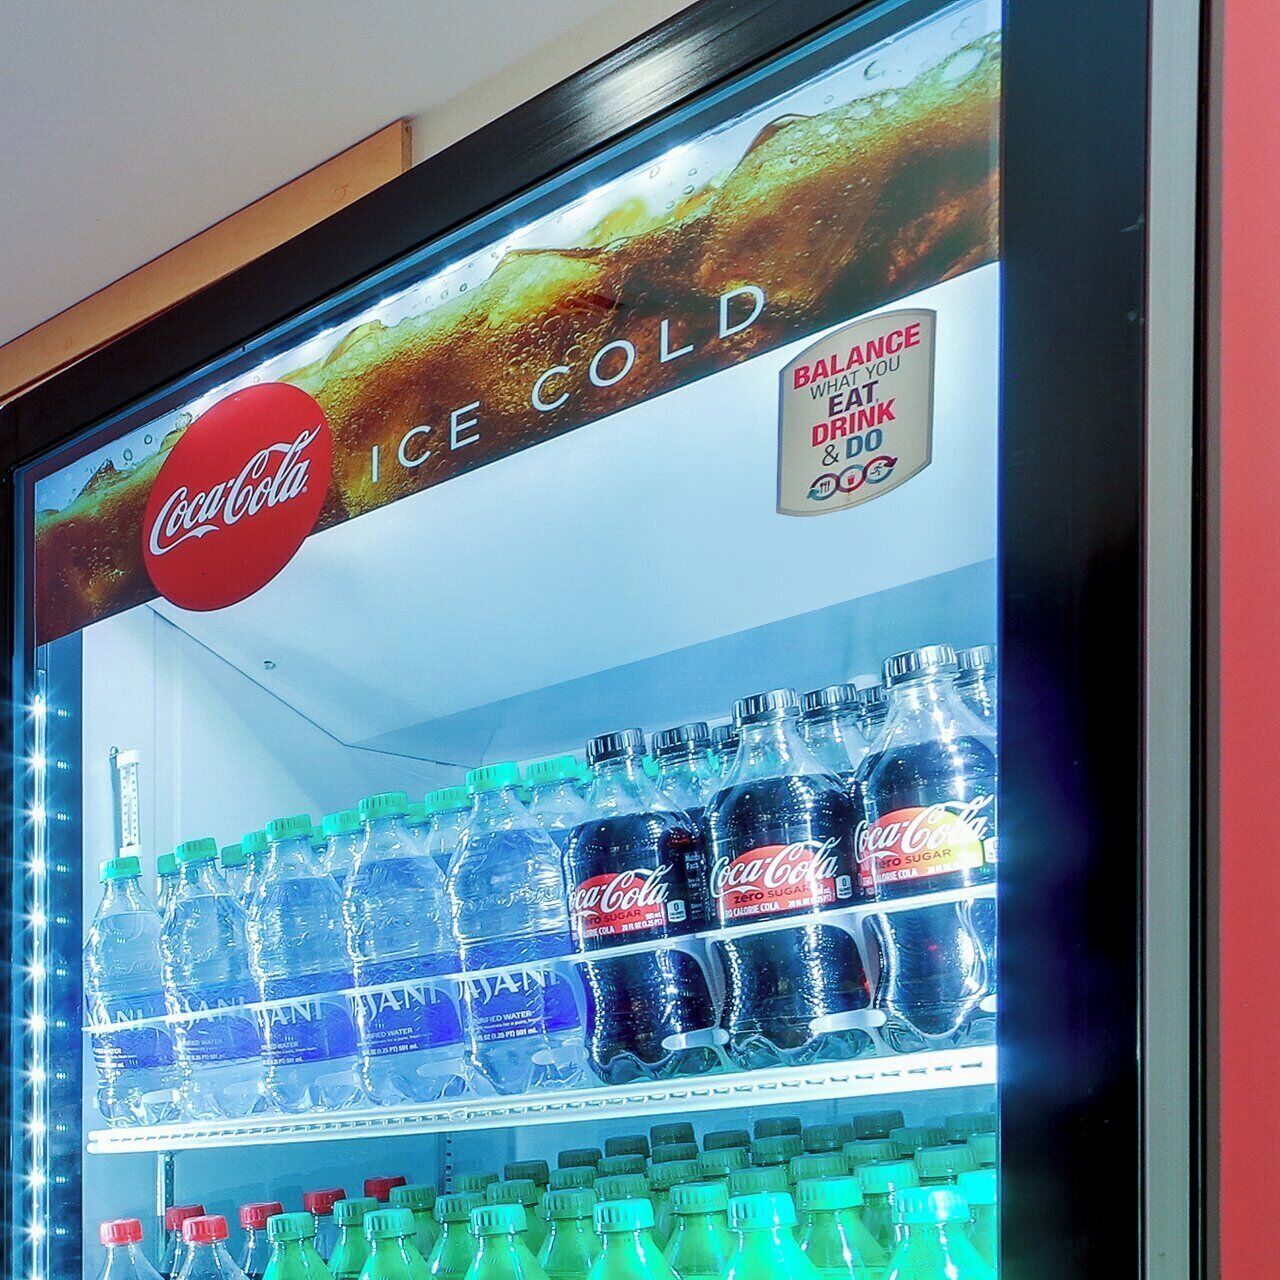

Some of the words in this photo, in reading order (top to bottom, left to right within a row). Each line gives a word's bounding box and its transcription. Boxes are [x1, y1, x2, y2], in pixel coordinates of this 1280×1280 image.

[793, 323, 921, 390] BALANCE
[810, 370, 858, 400] WHAT
[865, 355, 901, 380] YOU
[371, 400, 481, 484] ICE
[530, 283, 766, 414] COLD
[811, 398, 897, 448] DRINK
[821, 444, 840, 467] &
[846, 428, 884, 460] DO
[149, 424, 322, 556] Coca-Cola
[853, 794, 995, 865] Coca-Cola
[709, 836, 842, 898] Coca-Cola
[905, 849, 952, 864] SUGAR
[733, 891, 764, 904] zero
[387, 1026, 413, 1037] WATER
[503, 1010, 532, 1020] WATER
